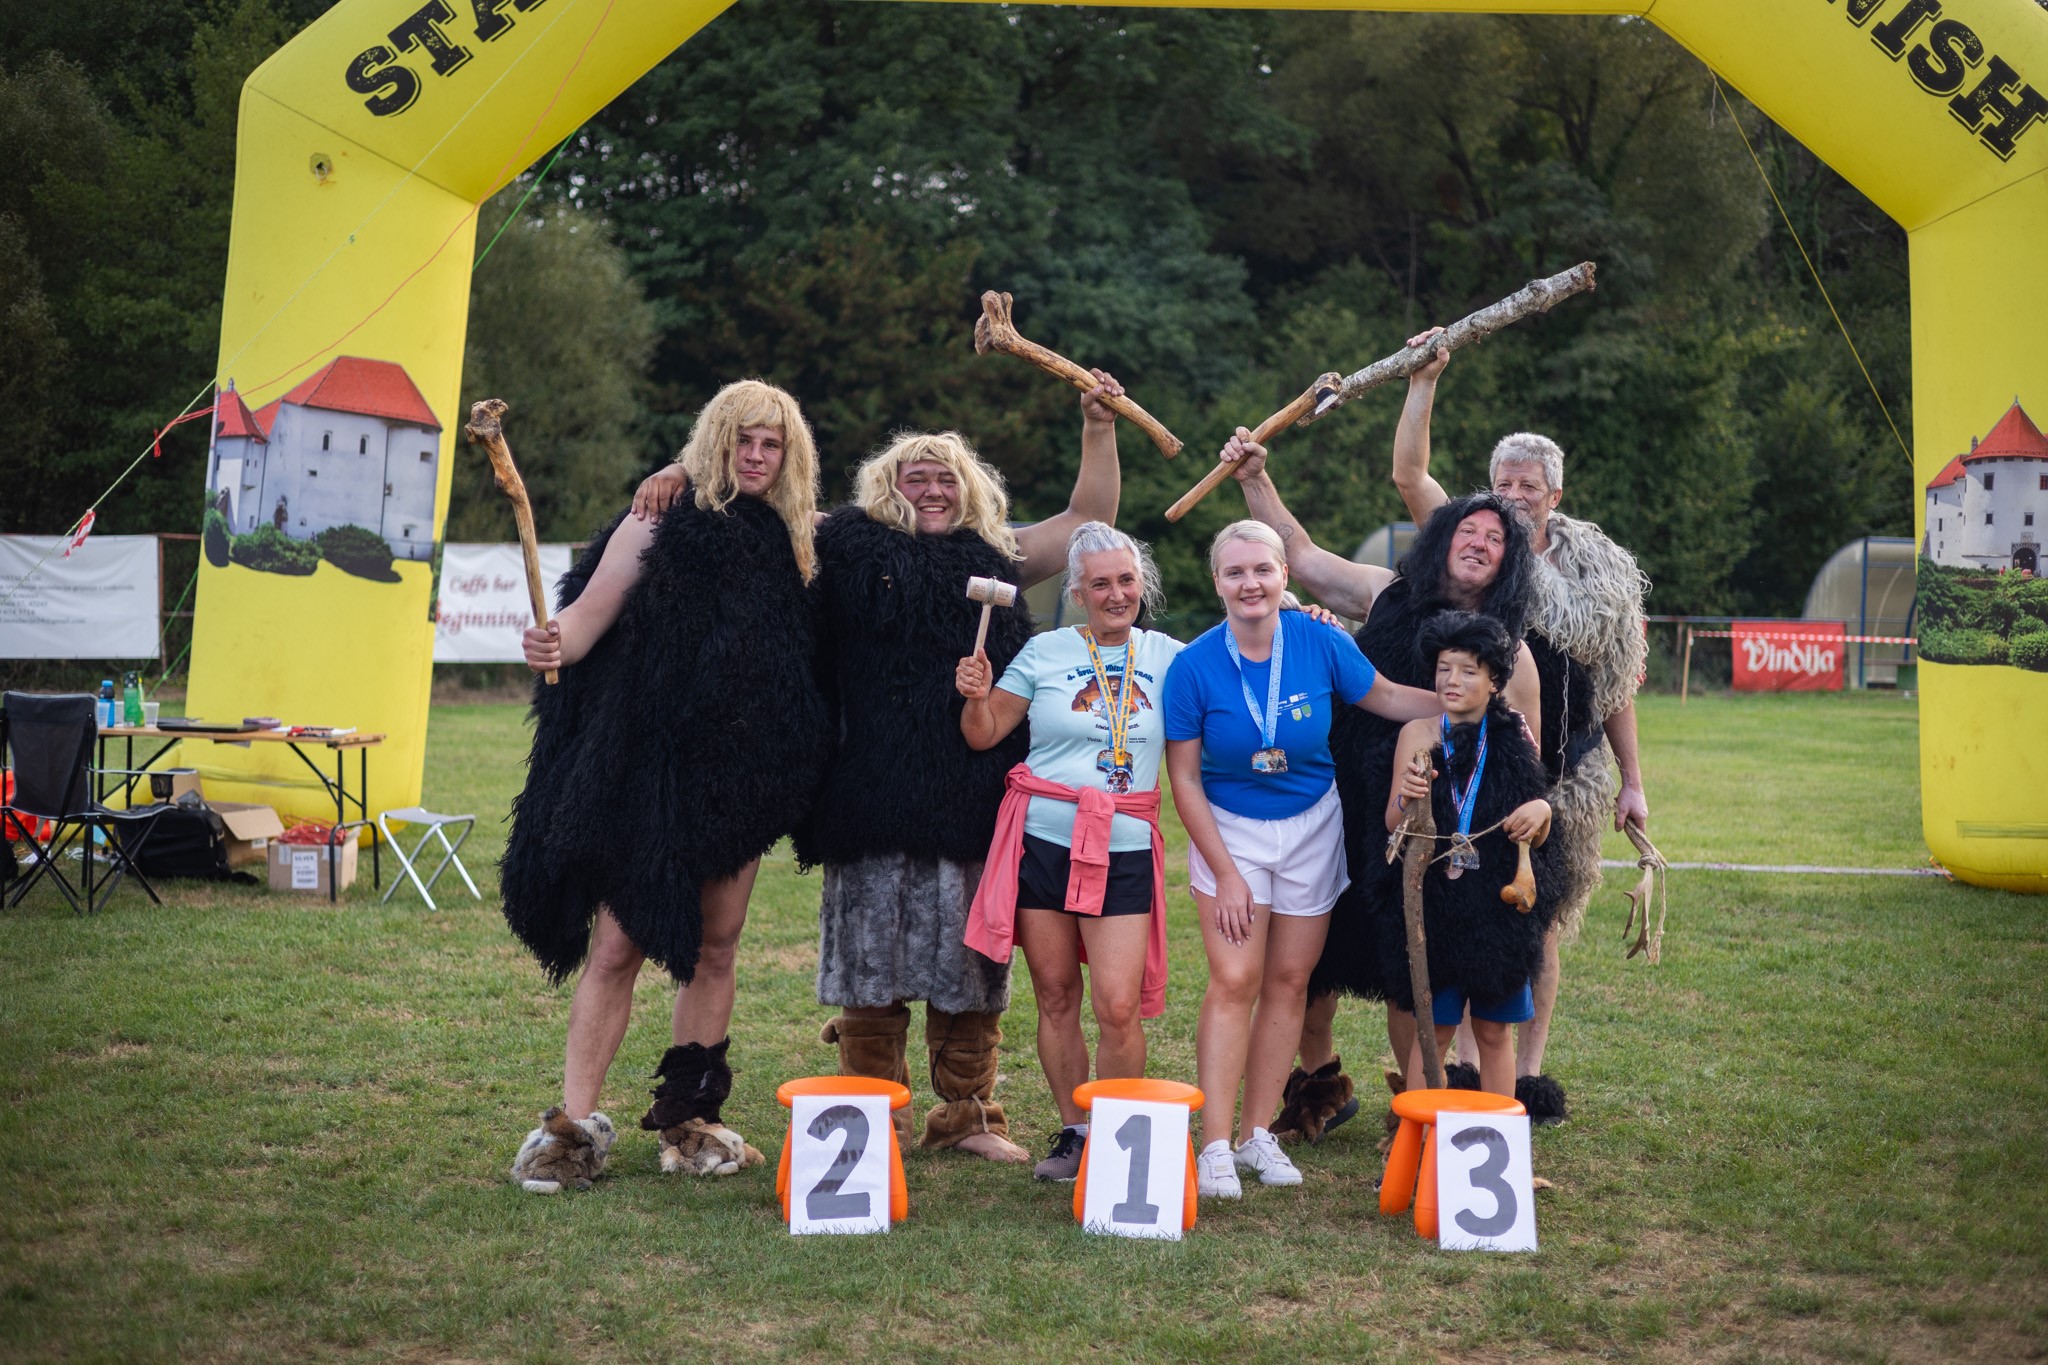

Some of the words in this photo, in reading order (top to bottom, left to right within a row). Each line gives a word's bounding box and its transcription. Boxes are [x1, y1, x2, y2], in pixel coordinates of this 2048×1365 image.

[1133, 669, 1154, 683] TRAIL
[1742, 638, 1836, 676] Vindija
[807, 1104, 871, 1221] 2
[1112, 1114, 1160, 1224] 1
[1449, 1126, 1518, 1238] 3
